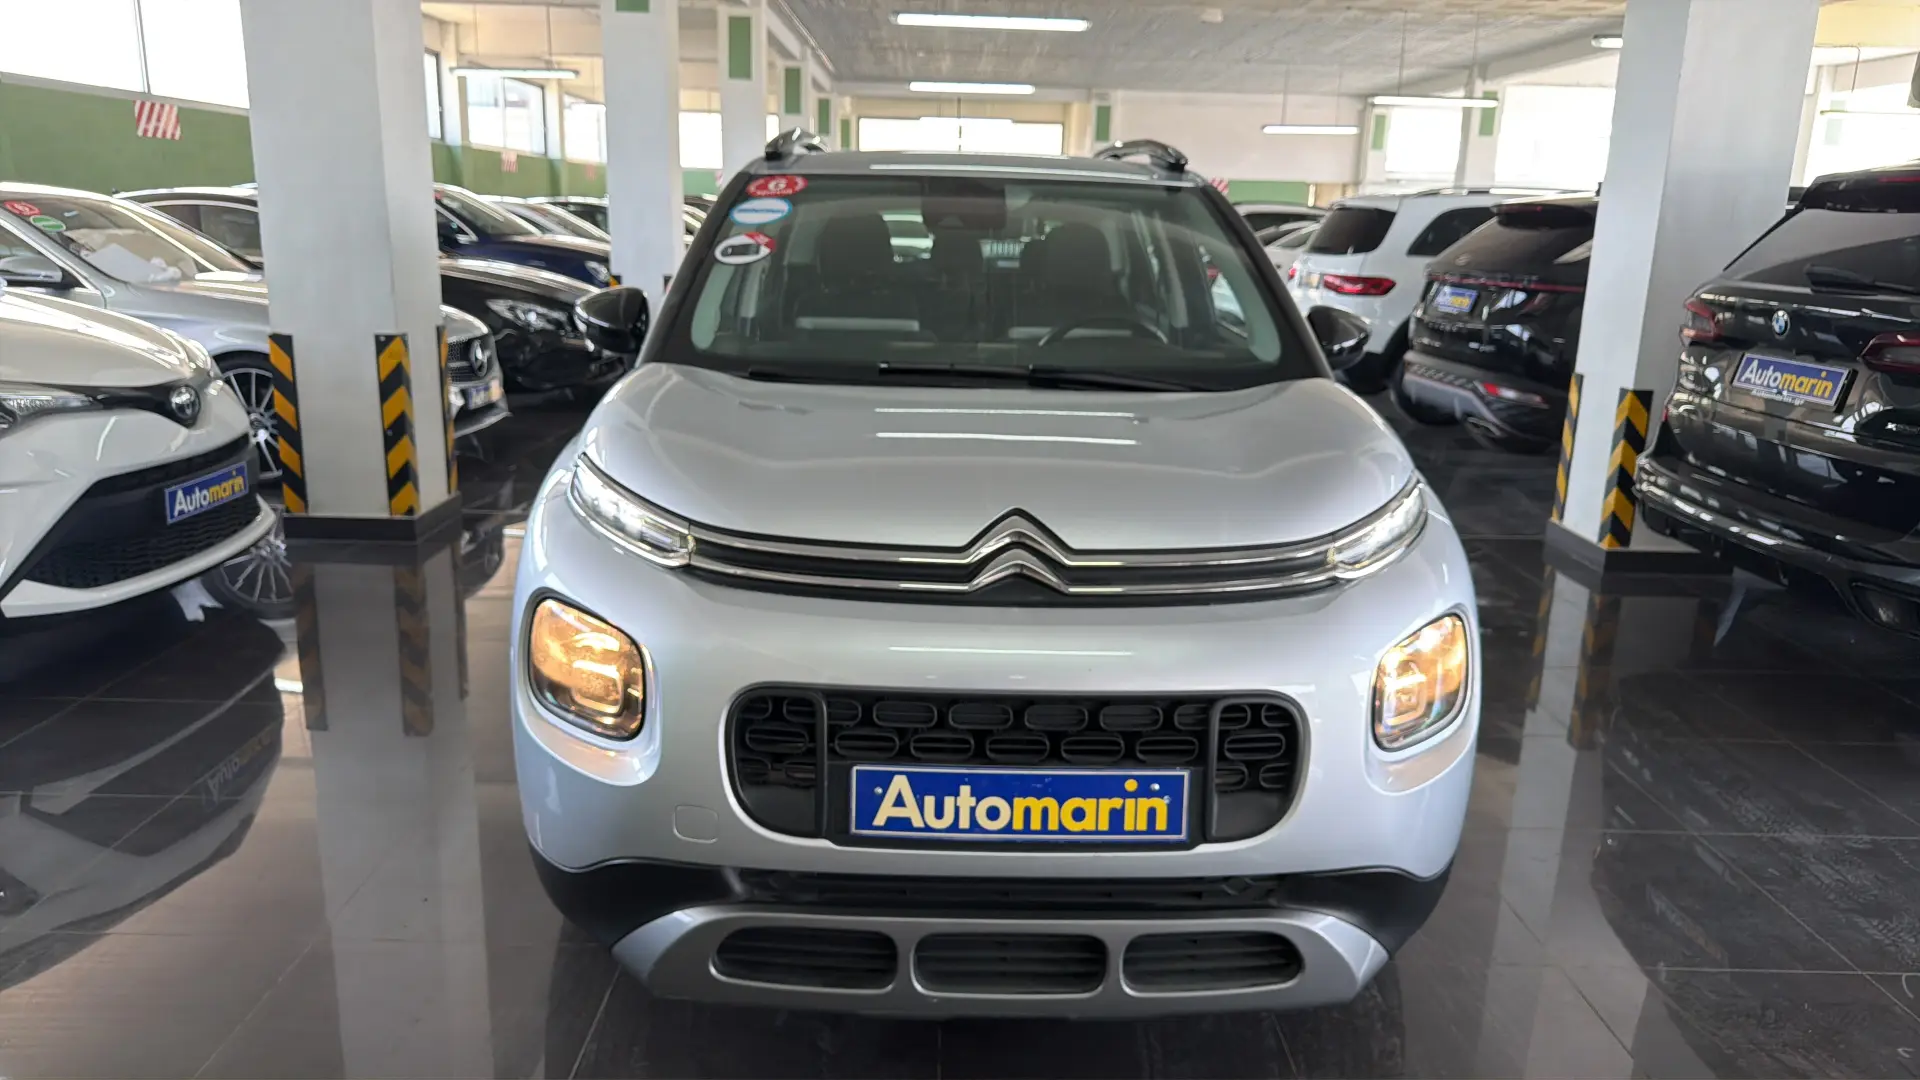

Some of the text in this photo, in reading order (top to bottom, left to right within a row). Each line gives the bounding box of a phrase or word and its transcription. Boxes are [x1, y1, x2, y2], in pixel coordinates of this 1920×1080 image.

[1741, 359, 1833, 398] Automarin
[173, 469, 245, 517] Automarin
[871, 774, 1169, 832] Automarin
